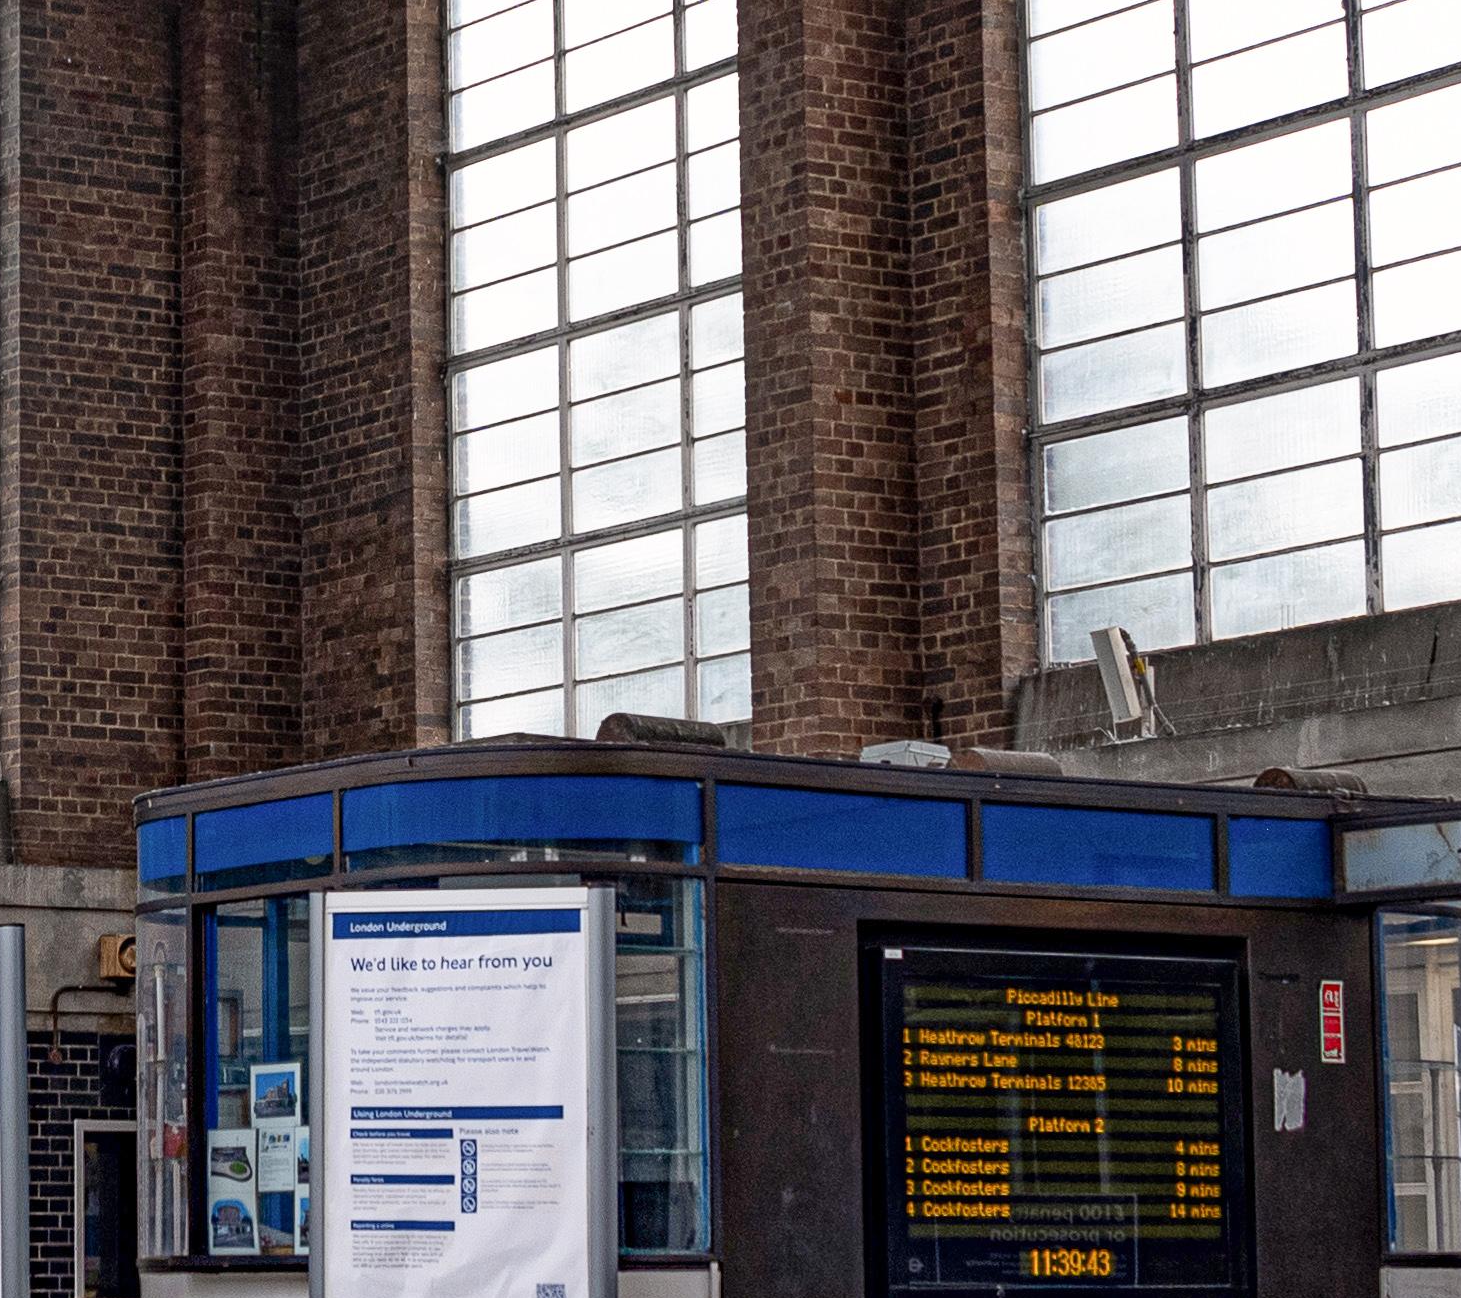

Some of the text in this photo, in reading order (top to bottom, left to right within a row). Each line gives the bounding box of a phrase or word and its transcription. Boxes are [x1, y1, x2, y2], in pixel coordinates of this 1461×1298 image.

[350, 920, 447, 933] London Underground
[351, 955, 552, 972] We'd like to hear from you
[1006, 988, 1119, 1007] Piccadilly Line
[1025, 1010, 1100, 1028] Platform 1
[903, 1027, 911, 1044] 1
[918, 1028, 985, 1045] Heathrow
[990, 1029, 1061, 1048] Terminals
[1172, 1036, 1182, 1052] 3
[1185, 1038, 1218, 1052] mins
[903, 1049, 1218, 1073] 2 Rayners Lane 8 mins
[904, 1070, 913, 1087] 3
[919, 1072, 987, 1088] Heathrow
[991, 1072, 1062, 1090] Terminals
[1167, 1077, 1183, 1093] 10
[1187, 1080, 1218, 1094] mins
[353, 1109, 452, 1120] Using London Underground
[1028, 1116, 1104, 1134] Platform 2
[905, 1135, 1220, 1156] 1 Cockfosters 4 mins
[905, 1157, 1221, 1177] 2 Cockfosters 8 mins
[906, 1179, 1221, 1198] 3 Cockfosters 9 mins
[906, 1201, 1222, 1219] 4 Cockfosters 14 mins
[1030, 1249, 1112, 1277] 11:39:43
